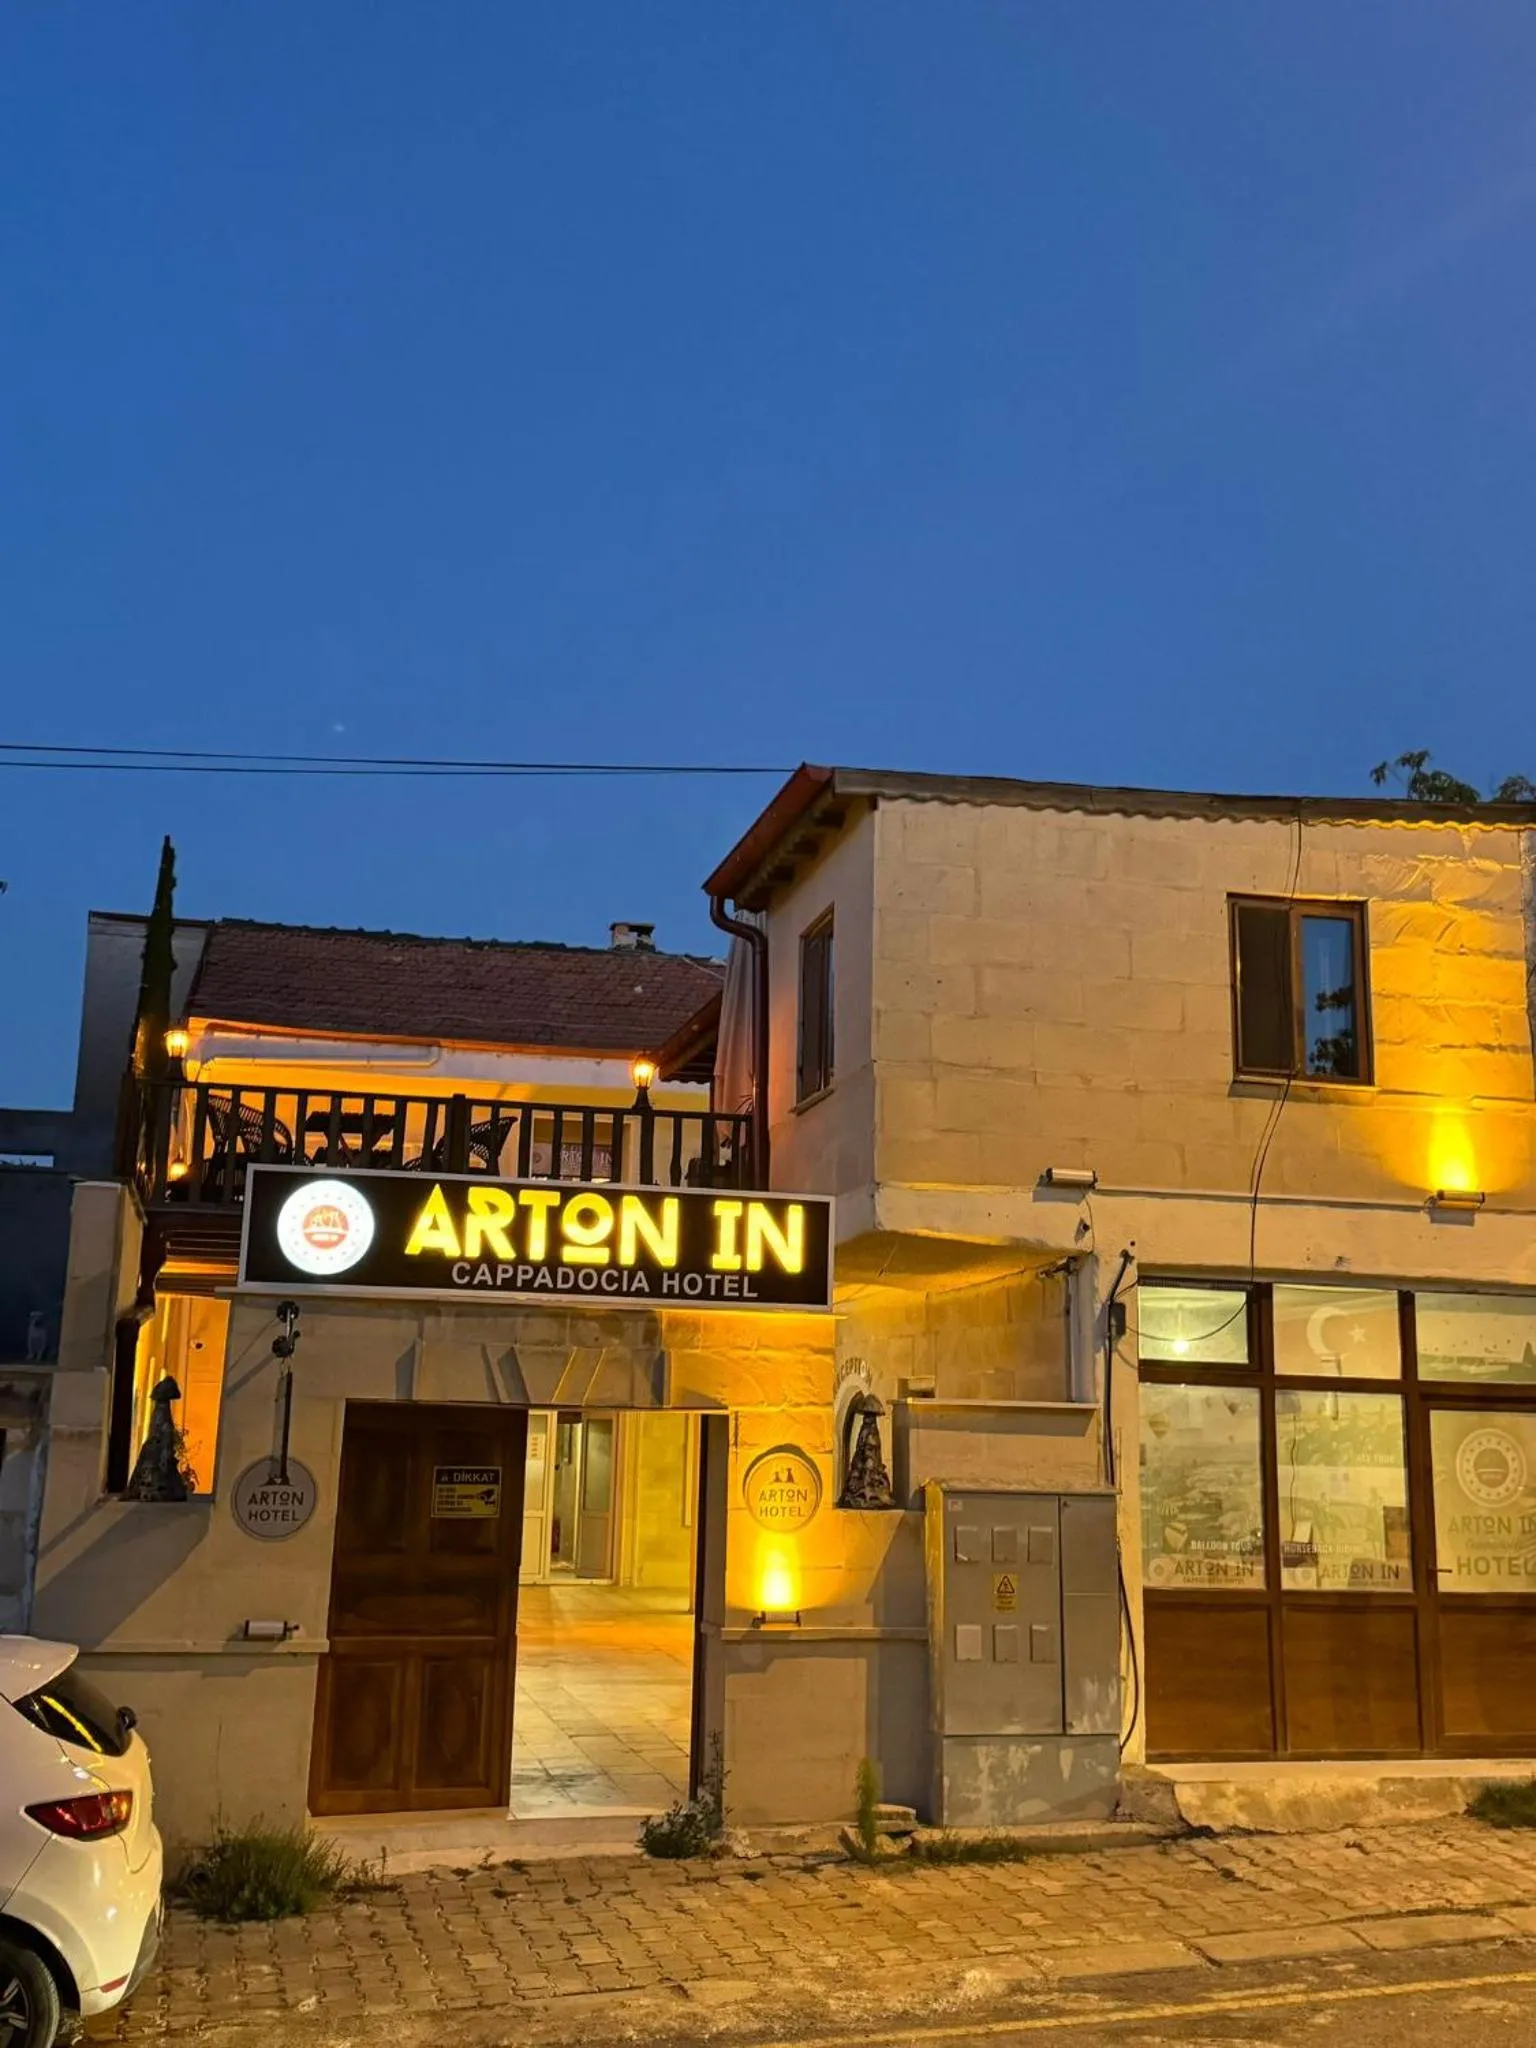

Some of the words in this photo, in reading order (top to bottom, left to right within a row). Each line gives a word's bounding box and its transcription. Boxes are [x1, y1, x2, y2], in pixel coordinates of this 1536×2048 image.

[404, 1183, 680, 1267] ARTON
[711, 1200, 805, 1273] IN
[452, 1261, 650, 1294] CAPPADOCIA
[662, 1272, 759, 1298] HOTEL
[247, 1490, 304, 1507] ARTON
[758, 1488, 808, 1503] ARTON
[248, 1509, 300, 1522] HOTEL
[758, 1506, 806, 1518] HOTEL
[1448, 1516, 1512, 1535] ARTON
[1175, 1560, 1229, 1577] ARTON
[1381, 1563, 1400, 1580] IN
[1456, 1556, 1536, 1576] HOTEL
